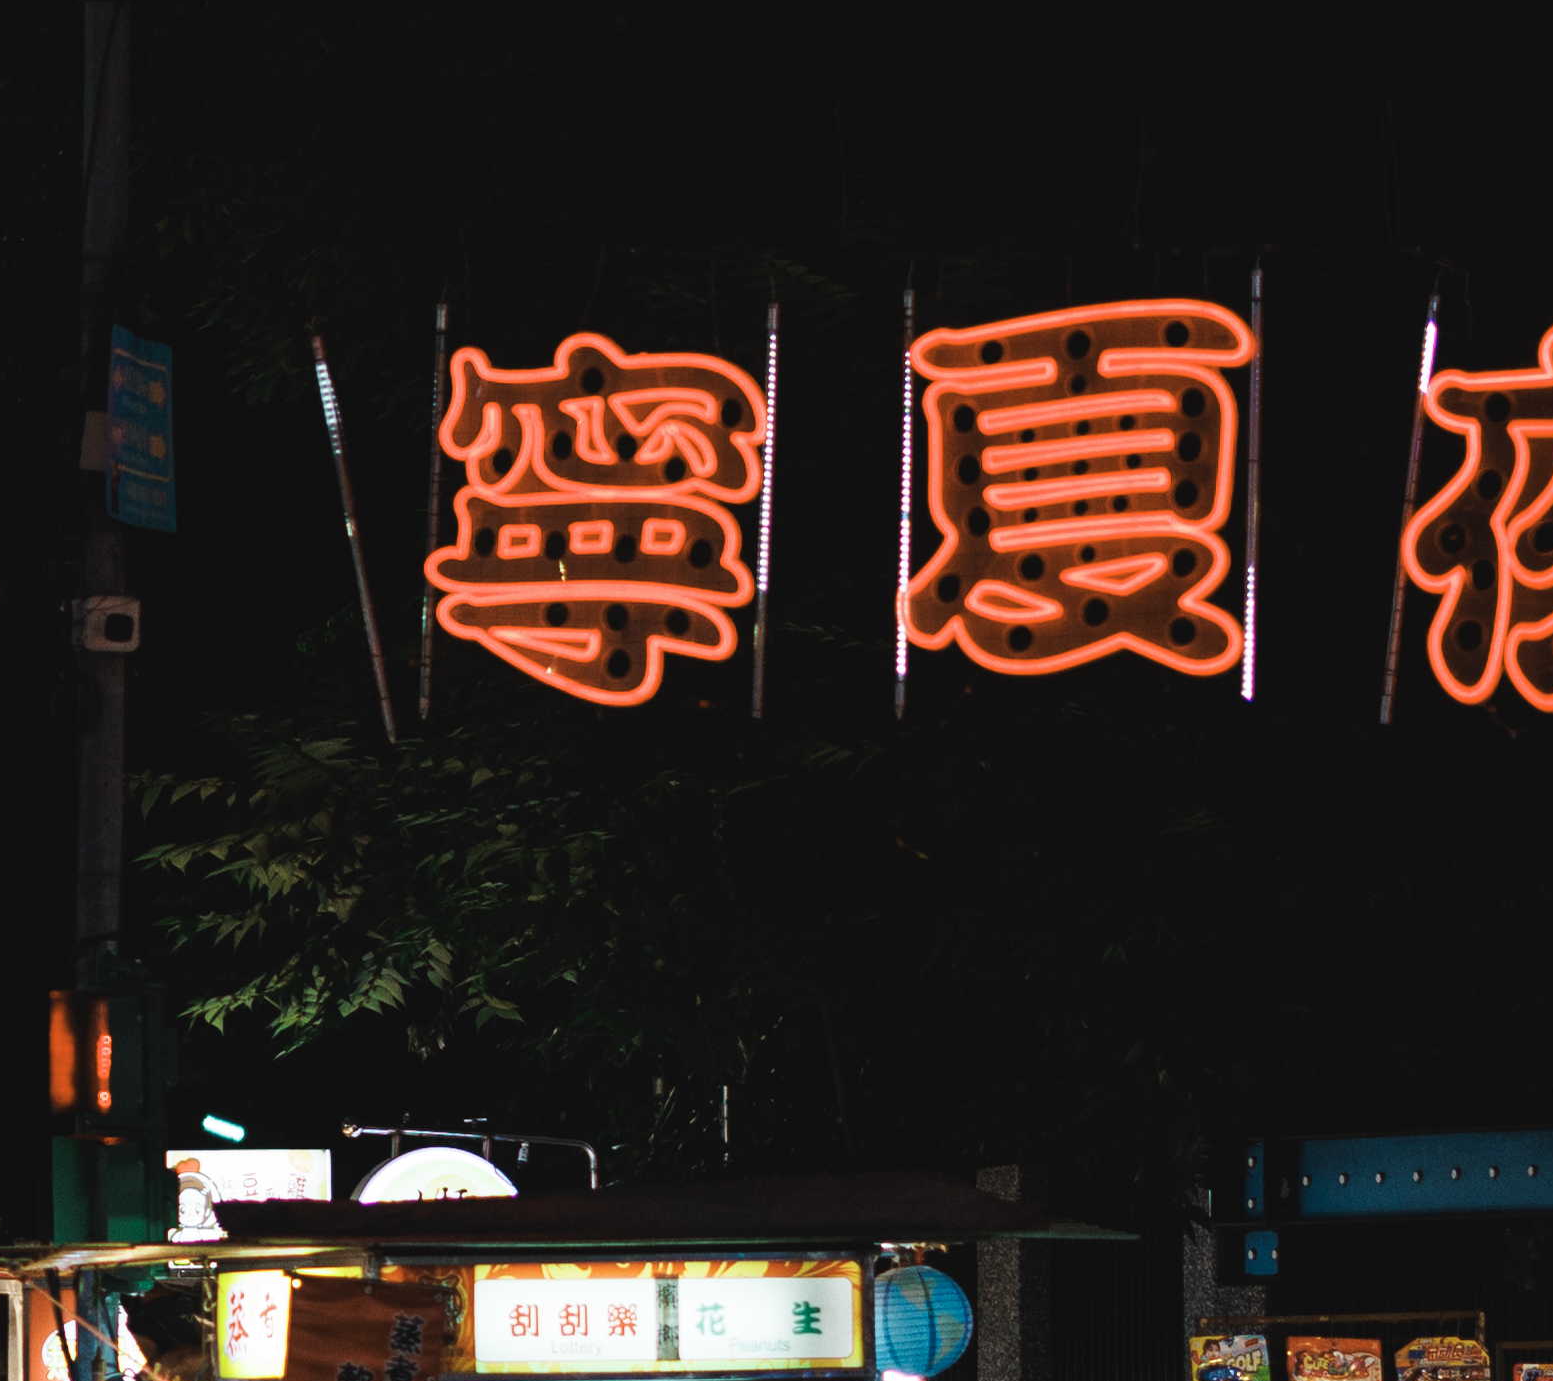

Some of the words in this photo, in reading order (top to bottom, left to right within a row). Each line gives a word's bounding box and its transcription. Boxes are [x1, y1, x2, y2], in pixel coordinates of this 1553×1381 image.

[509, 1303, 638, 1338] 刮刮樂
[695, 1300, 823, 1337] 花生
[550, 1340, 603, 1357] Lottery
[729, 1337, 791, 1353] Peanuts
[1225, 1348, 1263, 1374] GOLF
